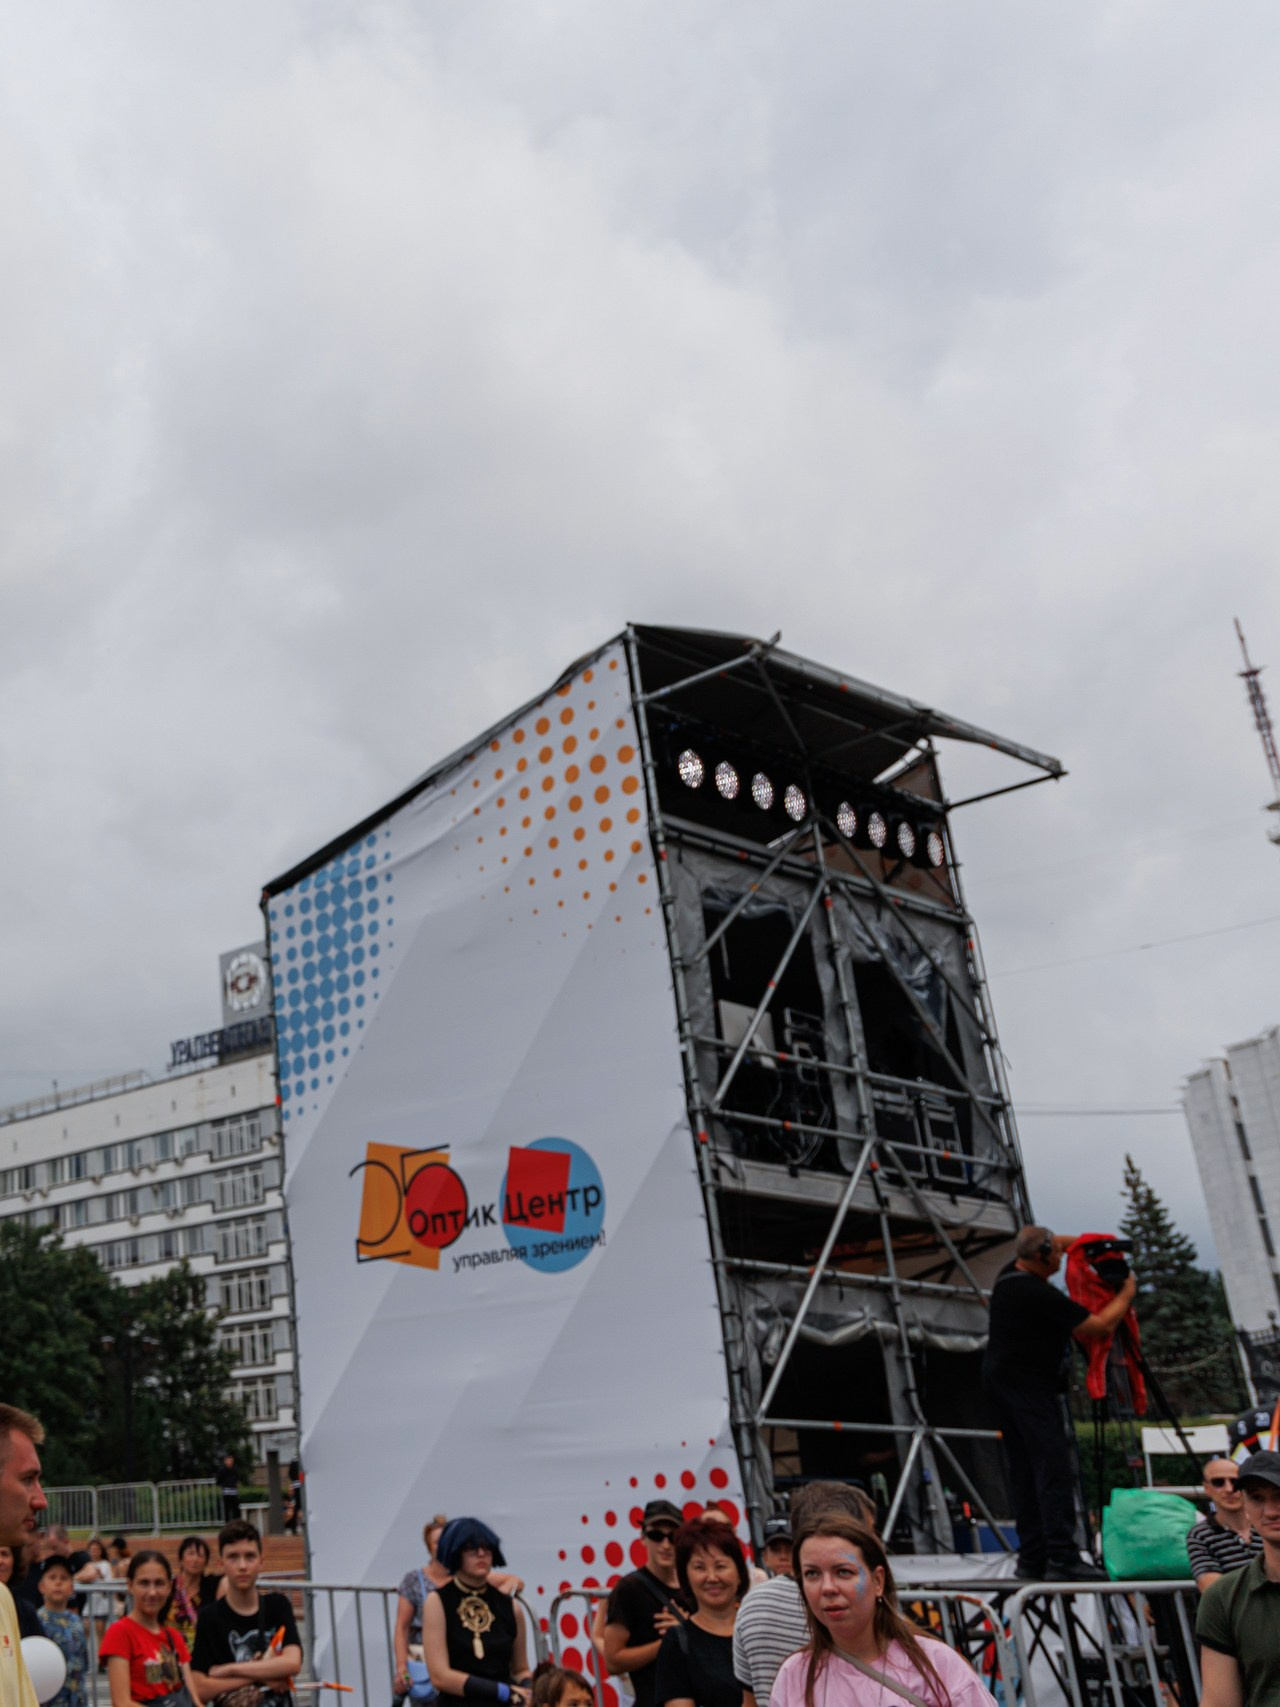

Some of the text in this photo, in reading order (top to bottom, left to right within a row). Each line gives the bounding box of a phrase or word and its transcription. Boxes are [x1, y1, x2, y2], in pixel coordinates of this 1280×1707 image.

[408, 1184, 602, 1238] Оптик Центр
[452, 1229, 607, 1273] управляя зрением!
